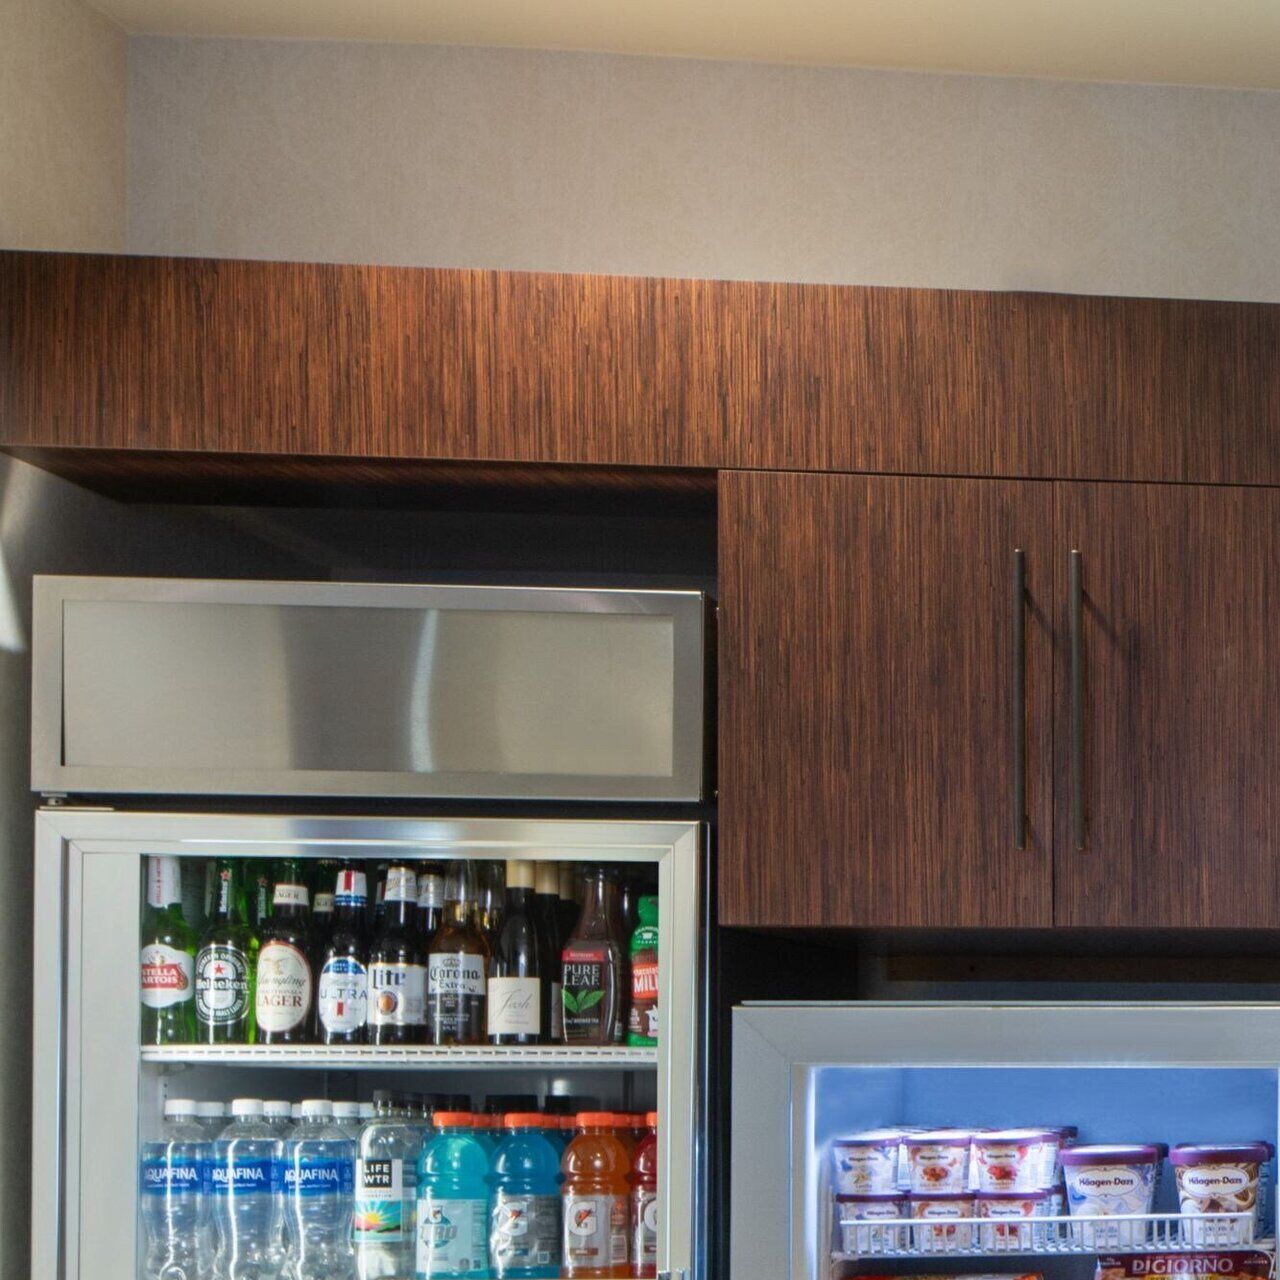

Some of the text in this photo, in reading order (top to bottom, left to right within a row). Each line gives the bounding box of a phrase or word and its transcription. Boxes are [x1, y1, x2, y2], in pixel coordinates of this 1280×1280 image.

[430, 967, 481, 982] Corona
[564, 964, 600, 976] PURE
[373, 969, 406, 990] Lite
[564, 975, 600, 987] LEAF
[320, 989, 369, 999] ULTRA
[363, 1164, 390, 1174] LIFE
[363, 1174, 391, 1185] WTR
[1132, 1258, 1233, 1275] DIGIORNO
